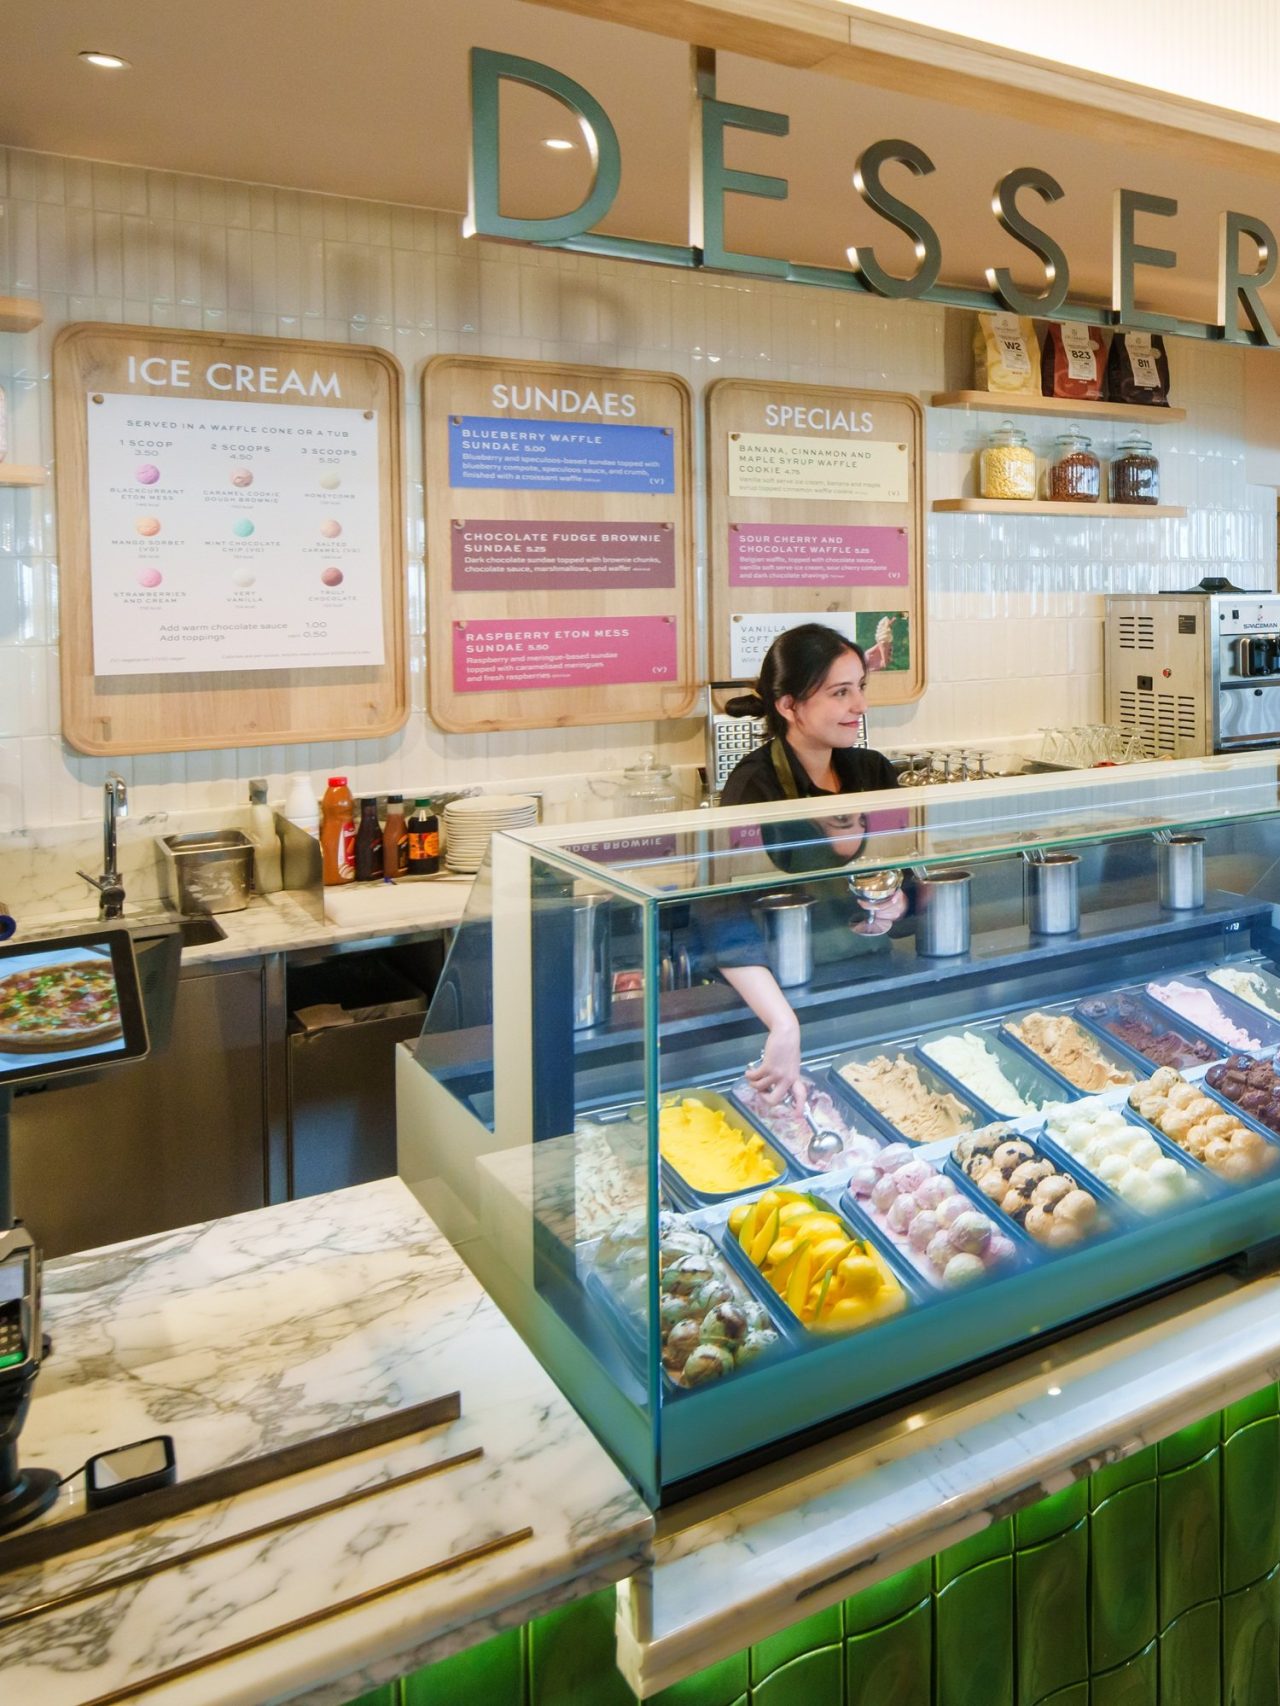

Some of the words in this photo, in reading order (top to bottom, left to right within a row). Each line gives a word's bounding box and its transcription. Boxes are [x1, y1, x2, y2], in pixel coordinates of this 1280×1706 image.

[1004, 341, 1021, 351] W2
[1072, 350, 1091, 360] 823
[1138, 359, 1150, 368] 811
[127, 355, 191, 388] ICE
[206, 362, 342, 399] CREAM
[492, 384, 637, 417] SUNDAES
[765, 404, 874, 433] SPECIALS
[127, 419, 177, 429] SERVED
[210, 424, 257, 433] WAFFLE
[261, 426, 293, 435] CONE
[297, 428, 312, 436] OR
[327, 430, 349, 438] TUB
[462, 428, 546, 441] BLUEBERRY
[550, 434, 602, 444] WAFFLE
[129, 440, 173, 448] SCOOP
[222, 444, 271, 453] SCOOPS
[462, 440, 520, 451] SUNDAE
[301, 447, 308, 455] 3
[312, 448, 358, 457] SCOOPS
[739, 444, 788, 455] BANANA,
[791, 447, 847, 458] CINNAMON
[850, 451, 872, 459] AND
[462, 453, 502, 462] Blueberry
[617, 460, 644, 468] topped
[739, 455, 776, 464] MAPLE
[779, 457, 814, 466] SYRUP
[818, 459, 857, 468] WAFFLE
[462, 462, 501, 471] blueberry
[739, 465, 780, 474] COOKIE
[462, 471, 497, 479] finished
[110, 487, 185, 495] BLACKCURRANT
[463, 532, 549, 542] CHOCOLATE
[553, 533, 598, 542] FUDGE
[601, 534, 662, 542] BROWNIE
[739, 535, 770, 543] SOUR
[774, 535, 818, 544] CHERRY
[820, 536, 843, 544] AND
[463, 544, 522, 553] SUNDAE
[739, 545, 807, 553] CHOCOLATE
[809, 546, 852, 554] WAFFLE
[464, 556, 485, 564] Dark
[486, 556, 526, 564] chocolate
[556, 557, 585, 565] topped
[160, 624, 180, 632] Add
[211, 623, 258, 631] chocolate
[305, 621, 327, 629] 1.00
[741, 625, 787, 633] VANILLA
[160, 634, 180, 642] Add
[182, 634, 226, 642] toppings
[303, 631, 328, 639] 0.50
[466, 630, 550, 642] RASPBERRY
[554, 630, 590, 639] ETON
[594, 629, 630, 638] MESS
[741, 635, 769, 644] SOFT
[466, 643, 523, 654] SUNDAE
[741, 646, 759, 654] ICE
[466, 656, 509, 664] Raspberry
[466, 665, 496, 674] topped
[497, 664, 514, 672] with
[483, 674, 505, 682] fresh
